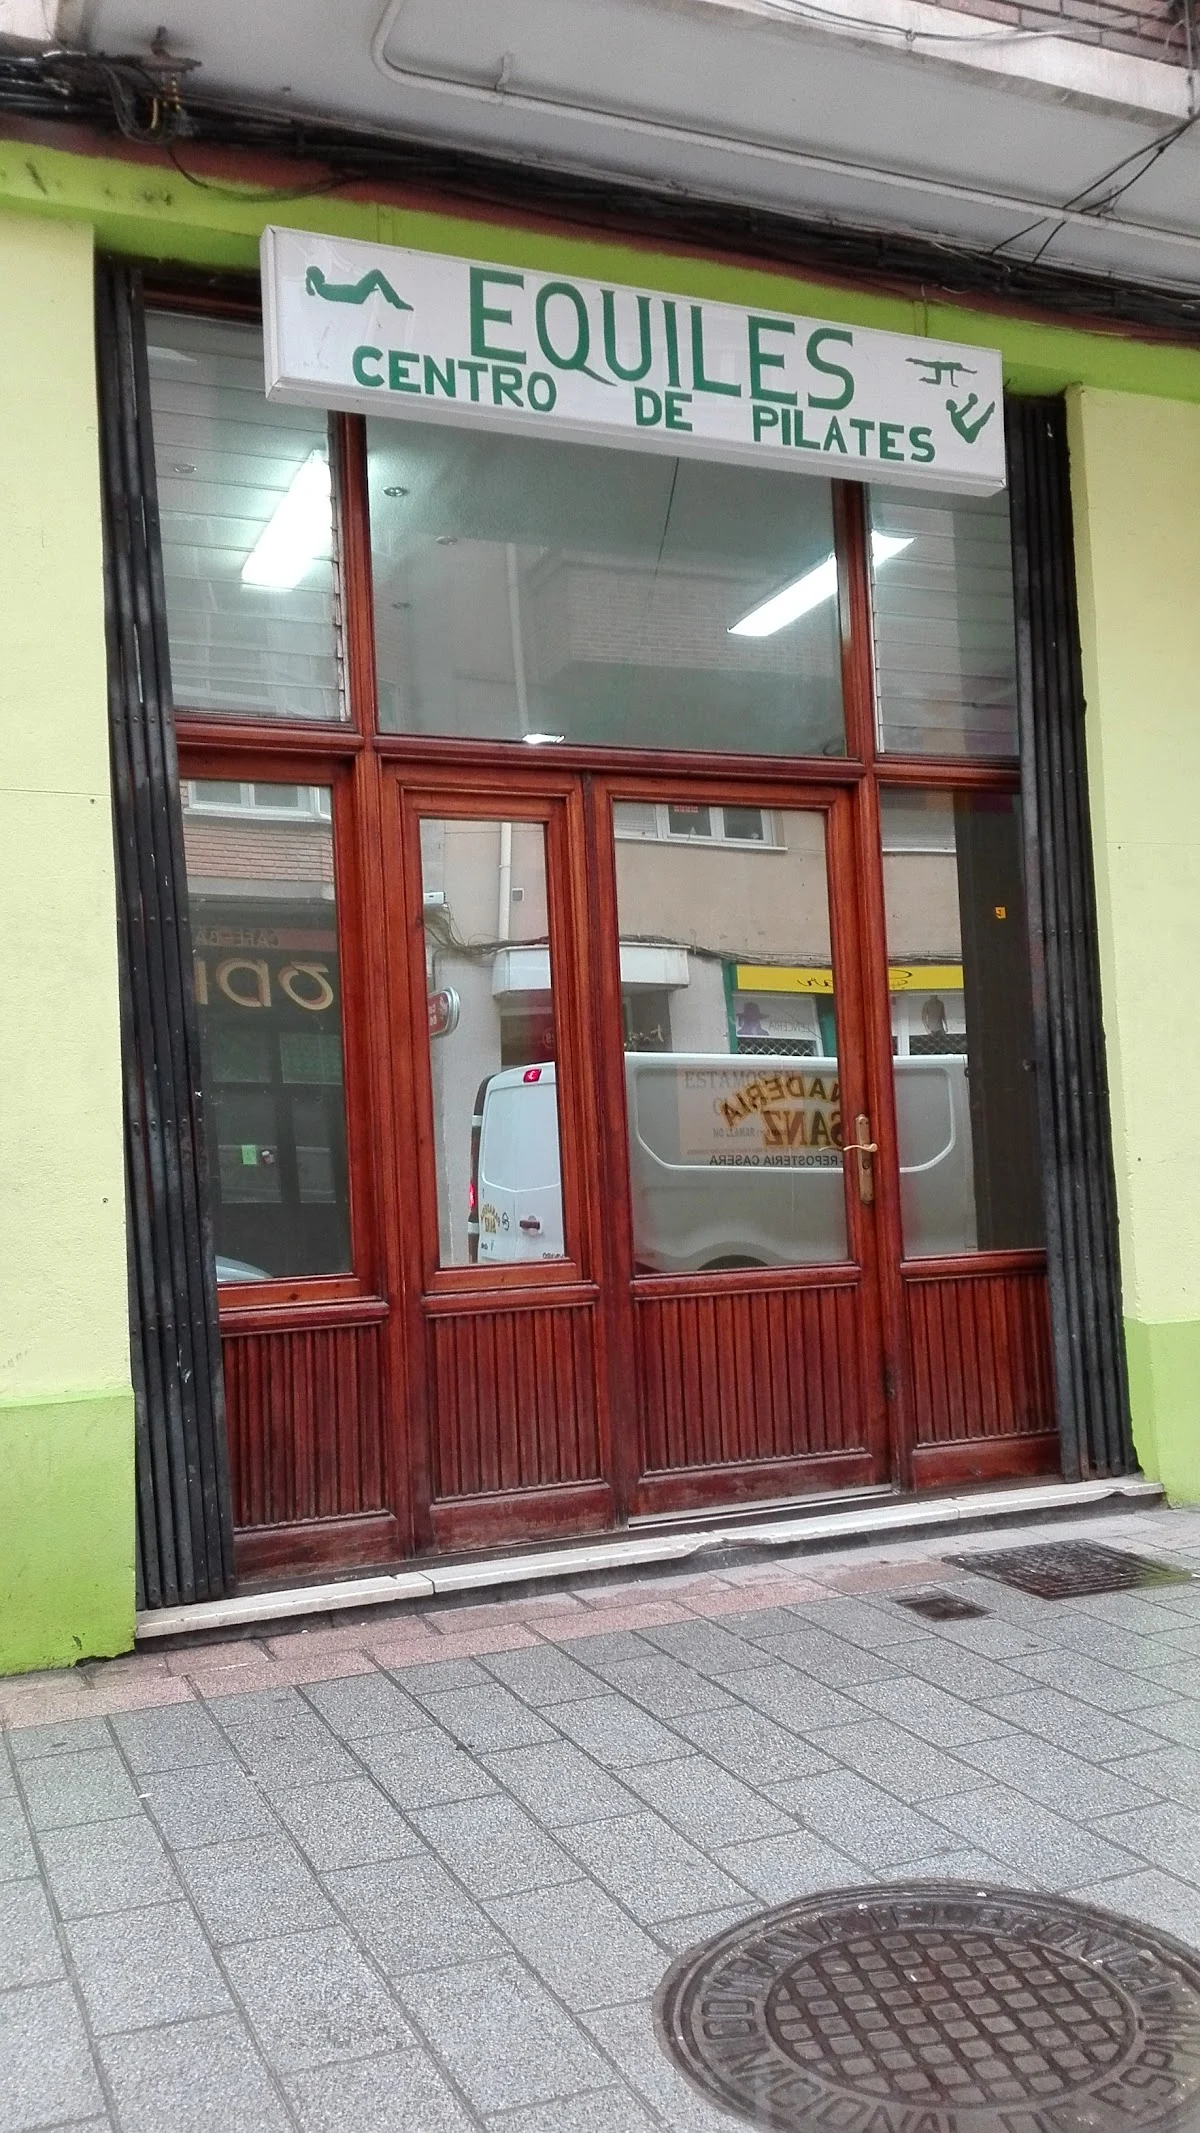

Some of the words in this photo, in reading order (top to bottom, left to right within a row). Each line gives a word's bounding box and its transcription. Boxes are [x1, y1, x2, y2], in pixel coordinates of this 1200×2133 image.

[351, 344, 558, 413] CENTRO
[635, 386, 694, 433] DE
[751, 405, 937, 463] PILATES
[468, 265, 857, 411] EQUILES
